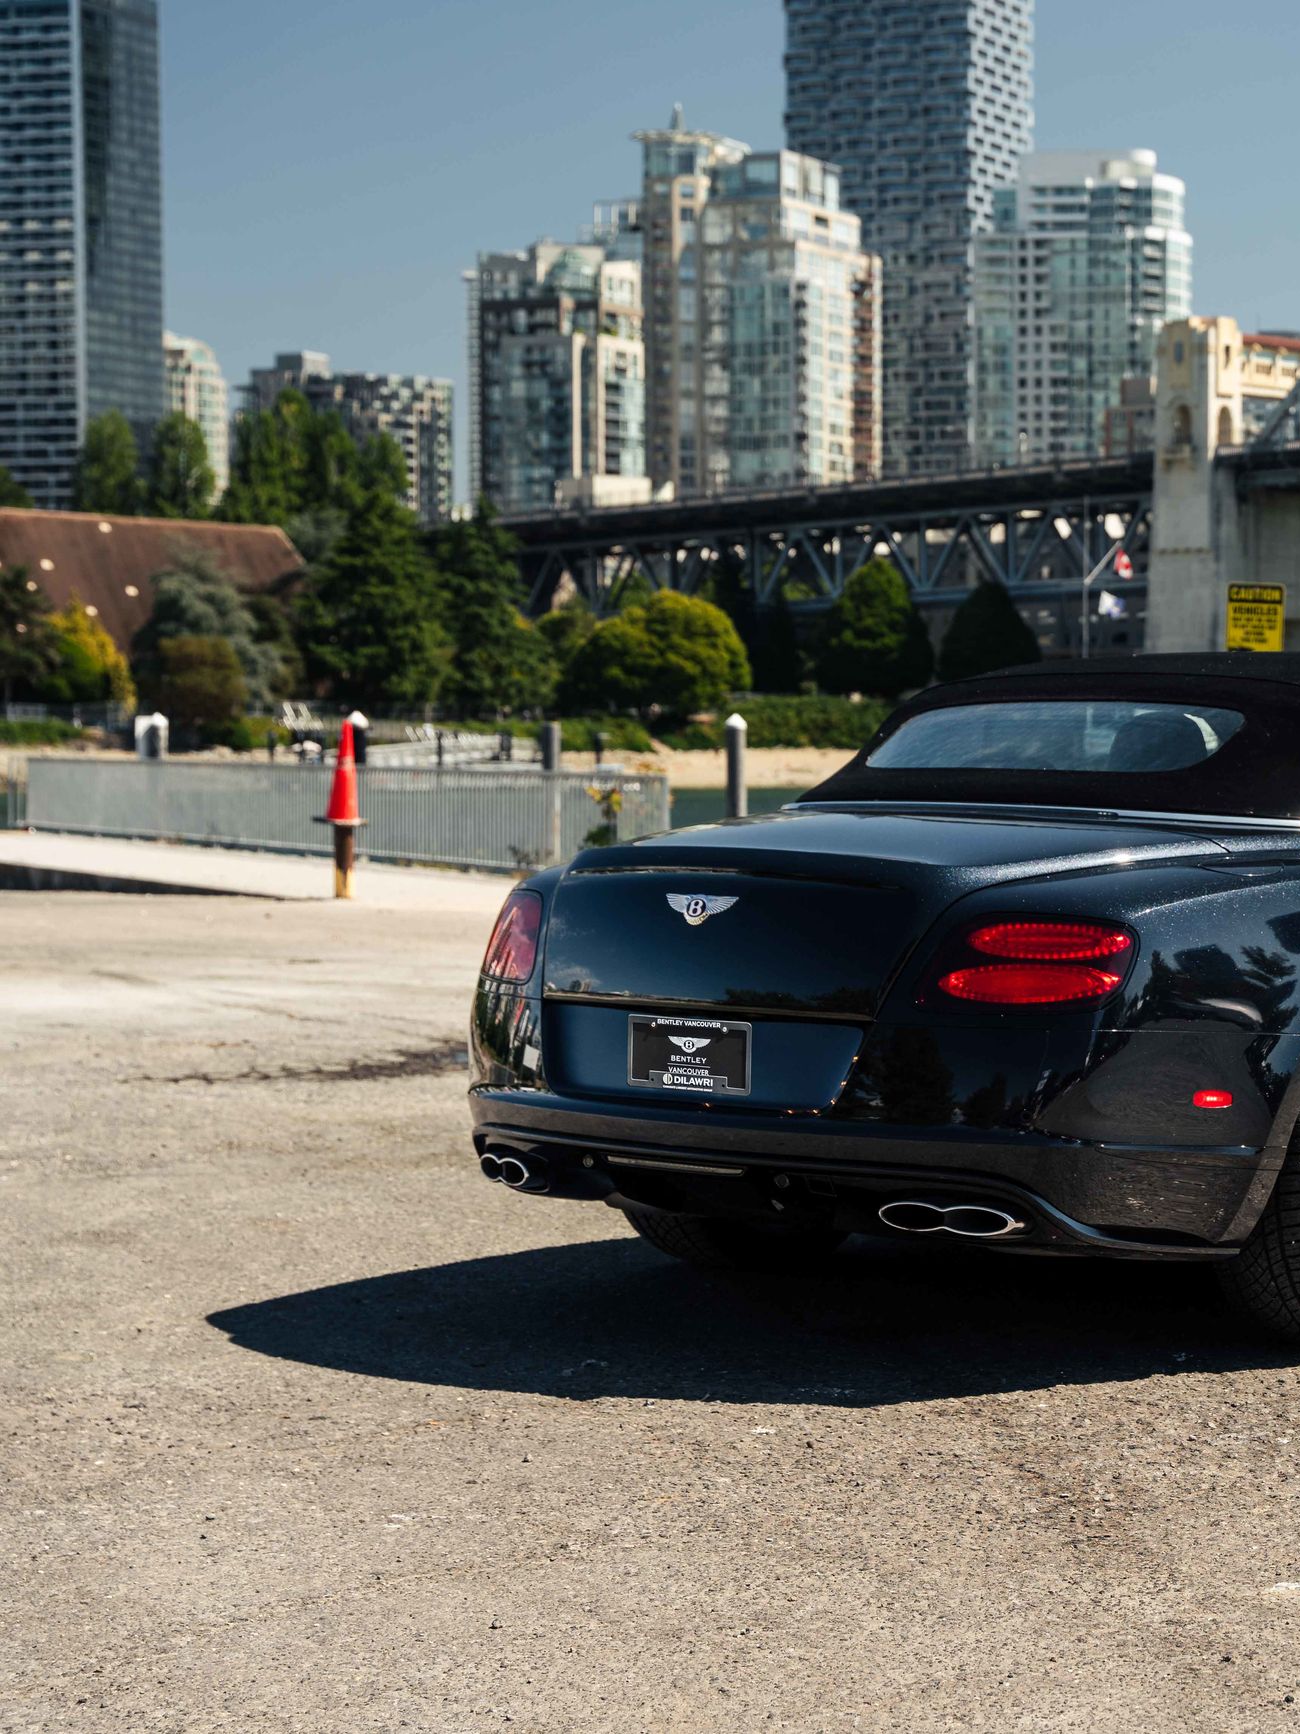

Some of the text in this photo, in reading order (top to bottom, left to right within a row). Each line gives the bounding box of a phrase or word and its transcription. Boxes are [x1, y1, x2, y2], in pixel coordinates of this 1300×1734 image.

[1231, 587, 1281, 601] CAUTION
[1232, 605, 1278, 616] VEHICLES
[657, 1018, 721, 1029] BENTLEY VANCOUVER
[670, 1054, 707, 1064] BENTLEY
[668, 1066, 710, 1076] VANCOUVER
[673, 1075, 714, 1087] DILAWRI
